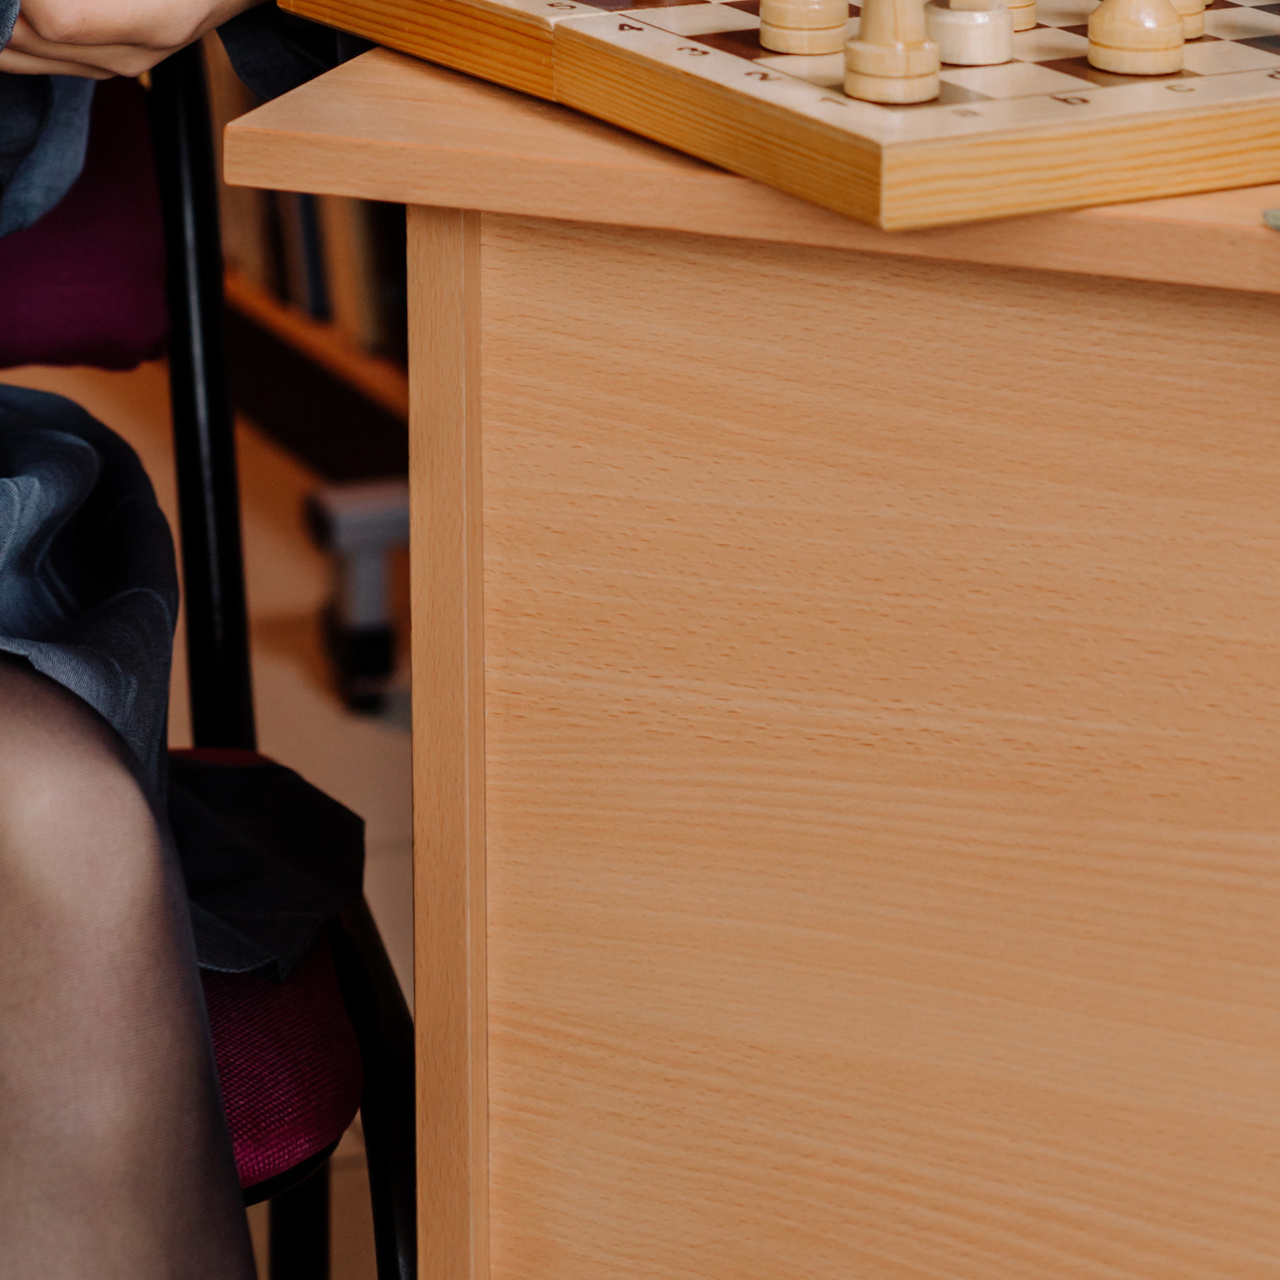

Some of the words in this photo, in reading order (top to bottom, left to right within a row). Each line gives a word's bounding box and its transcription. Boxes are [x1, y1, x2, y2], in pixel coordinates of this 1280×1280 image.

[546, 2, 577, 10] 5
[618, 23, 644, 32] 4
[676, 46, 710, 57] 3
[744, 71, 782, 82] 2
[819, 96, 848, 107] 1
[1049, 94, 1091, 106] b
[1164, 84, 1196, 94] c
